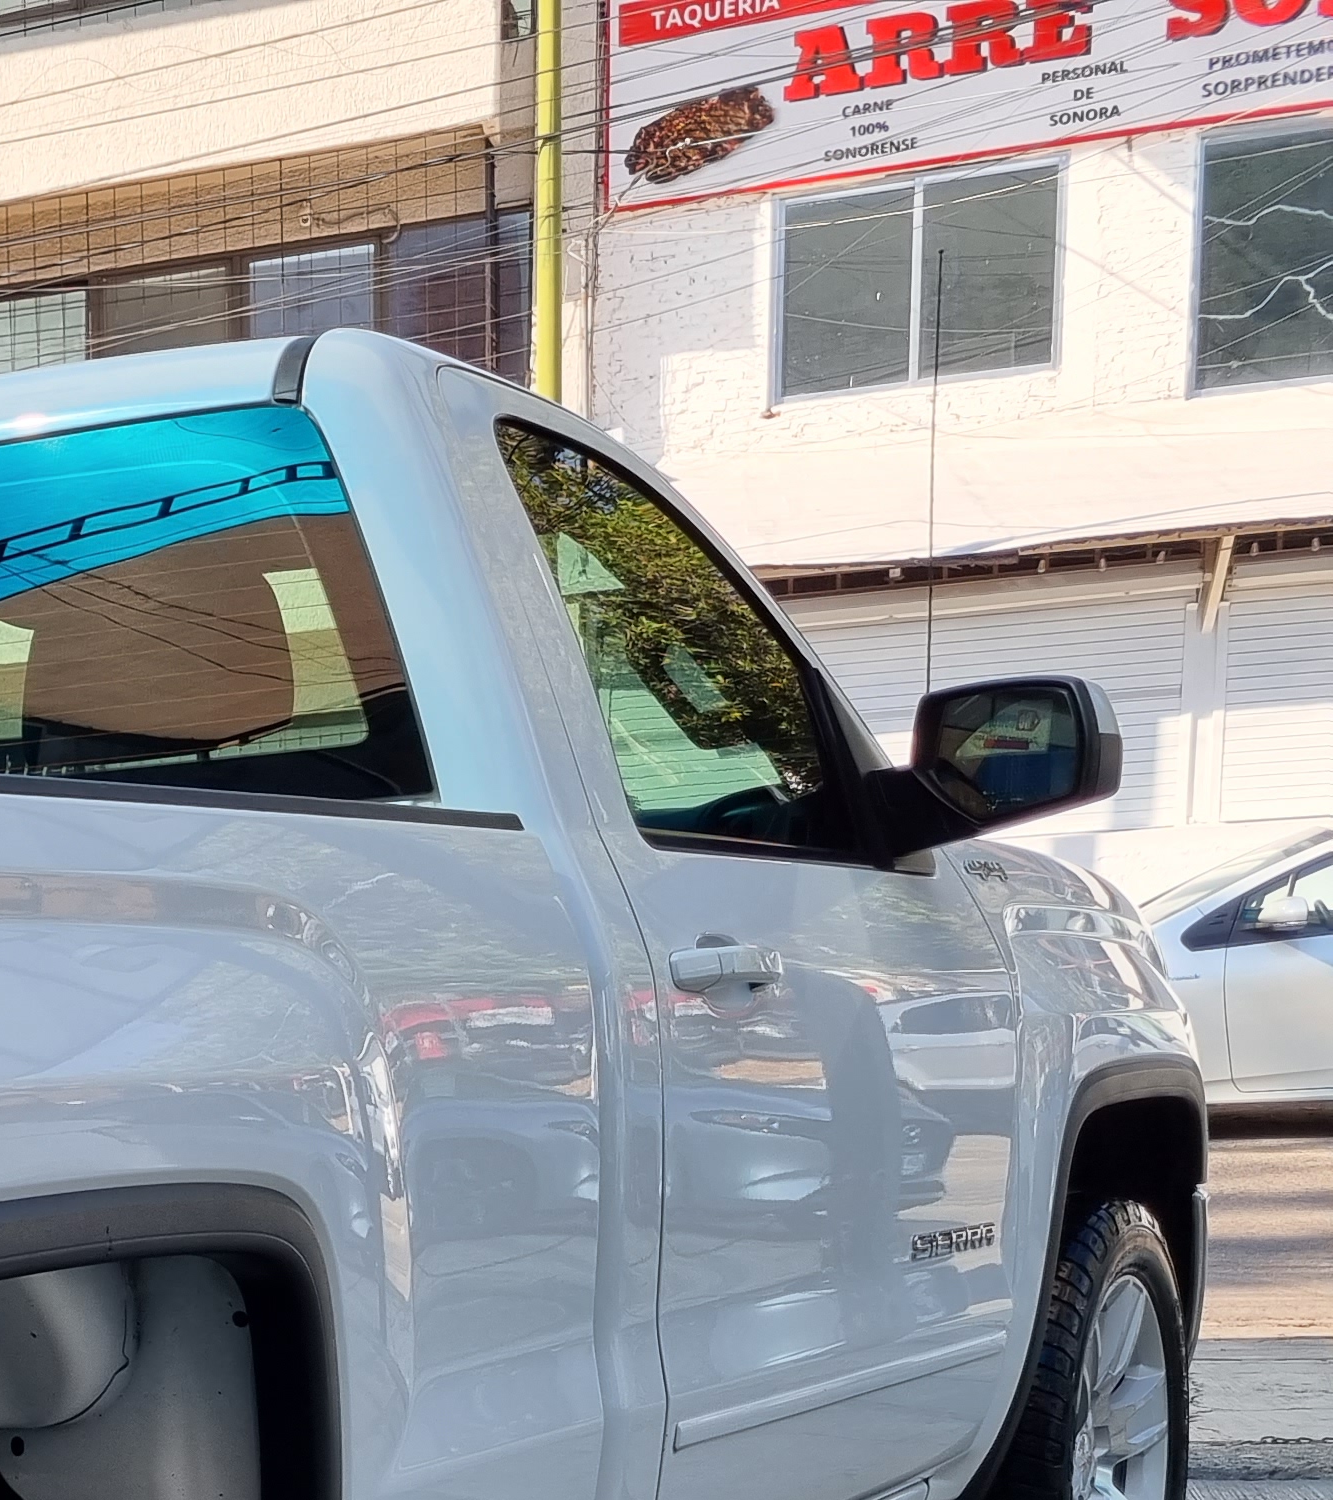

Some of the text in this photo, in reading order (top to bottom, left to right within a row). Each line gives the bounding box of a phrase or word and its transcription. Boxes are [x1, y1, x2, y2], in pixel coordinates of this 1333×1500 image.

[783, 0, 1092, 102] ARRE
[1041, 60, 1129, 85] PERSONAL
[1073, 86, 1095, 102] DE
[842, 99, 894, 119] CARNE
[1049, 104, 1122, 127] SONORA
[849, 120, 890, 138] 100%
[823, 136, 919, 162] SONORENSE
